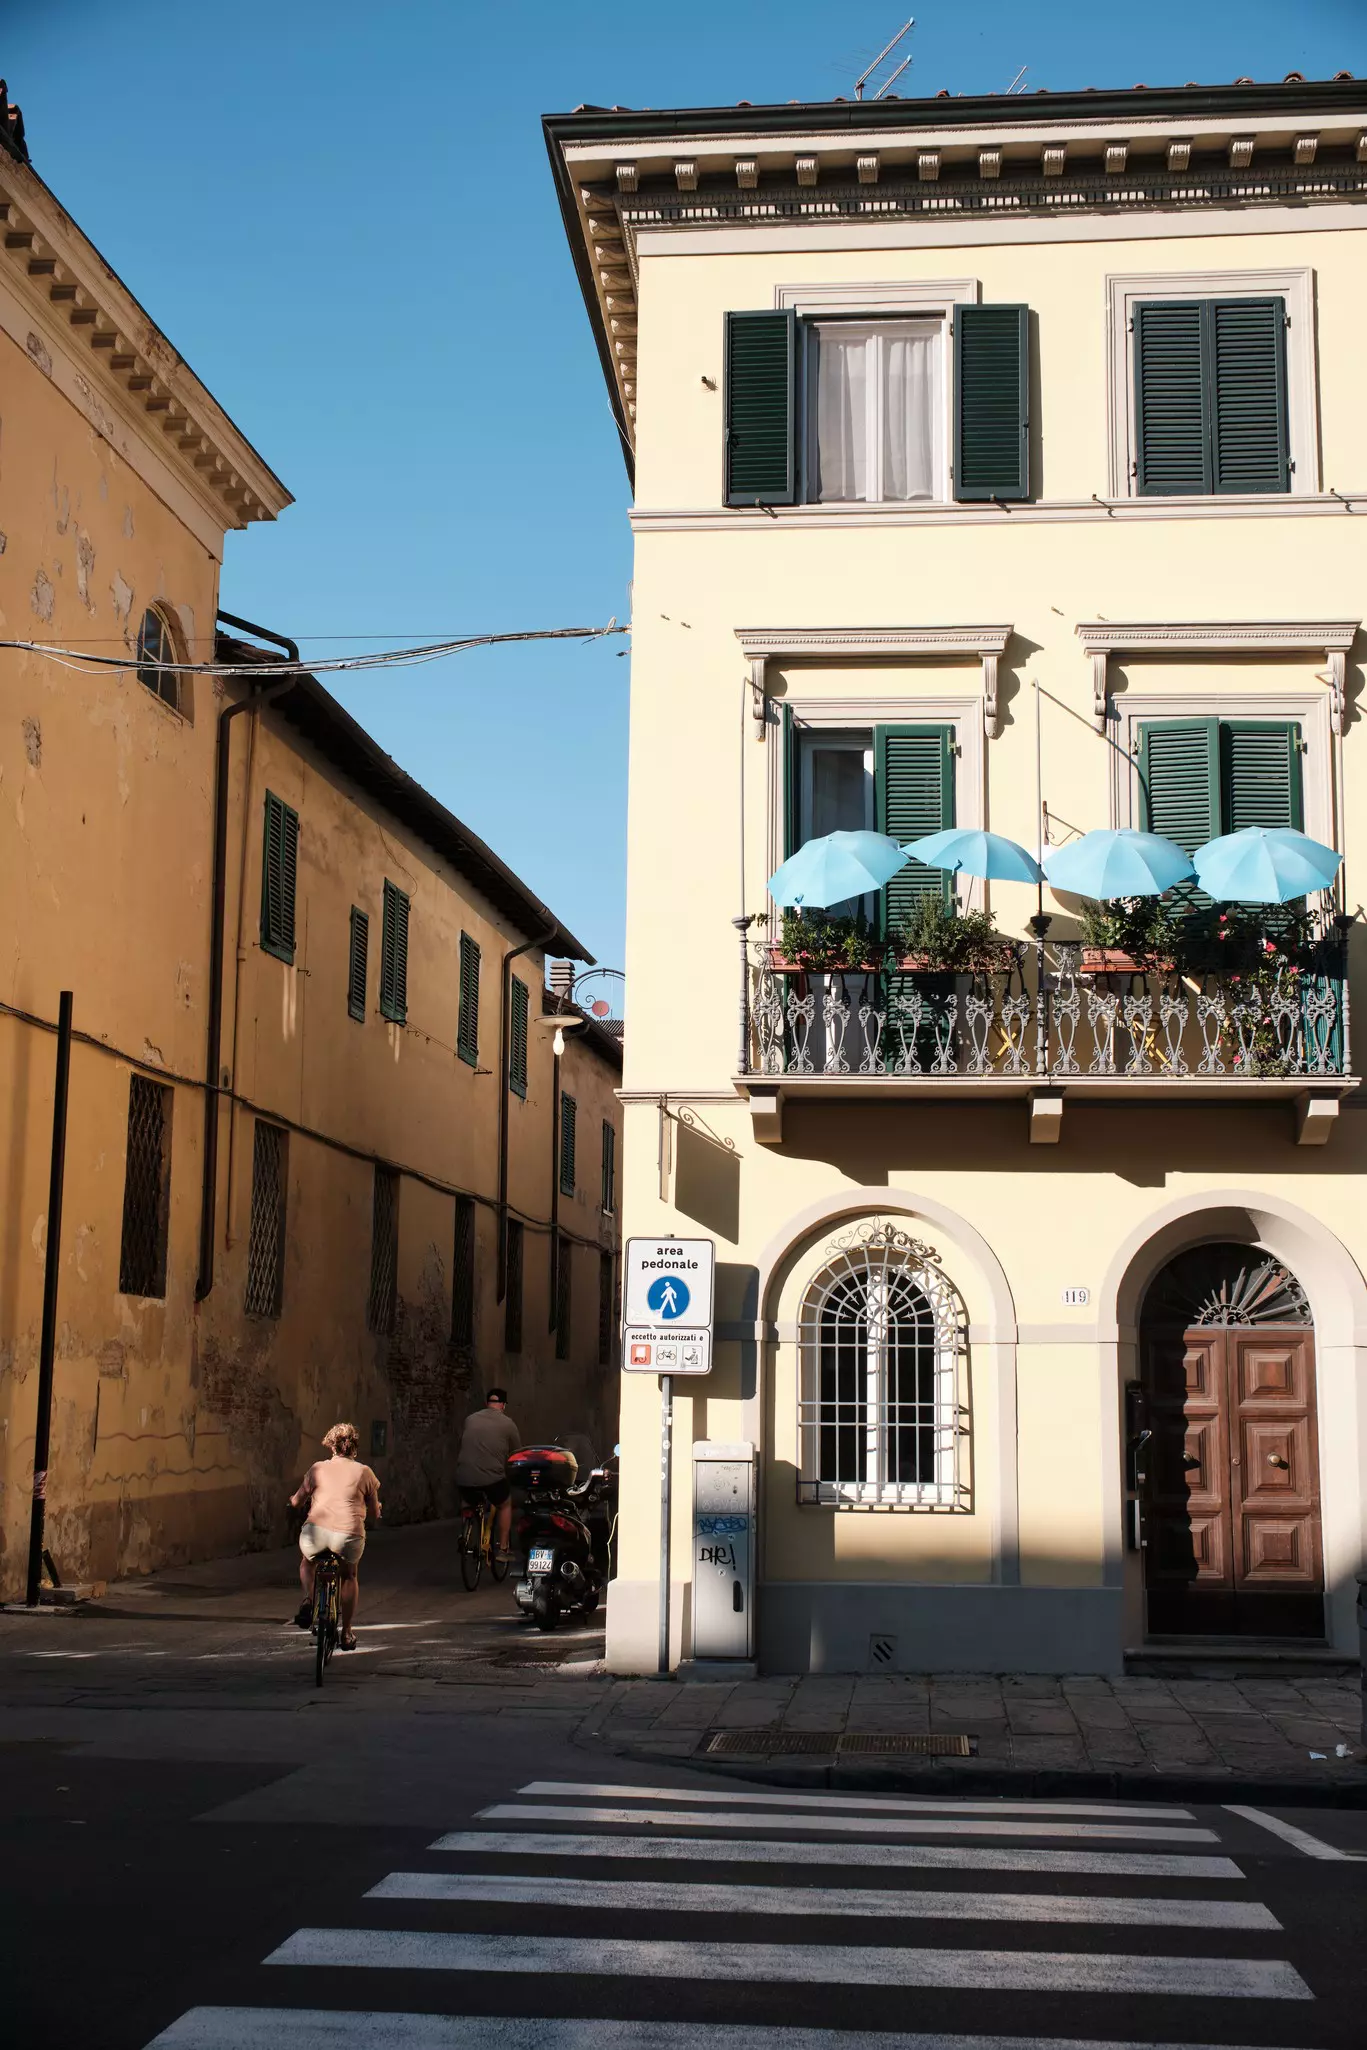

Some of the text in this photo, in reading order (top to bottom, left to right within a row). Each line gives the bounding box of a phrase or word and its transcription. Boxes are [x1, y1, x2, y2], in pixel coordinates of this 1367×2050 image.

[656, 1247, 684, 1256] area
[641, 1259, 699, 1271] pedonale
[1065, 1290, 1087, 1303] 119
[631, 1333, 657, 1341] eccetto
[659, 1333, 697, 1342] autorizzati
[535, 1550, 545, 1559] BV
[530, 1560, 552, 1570] 99124
